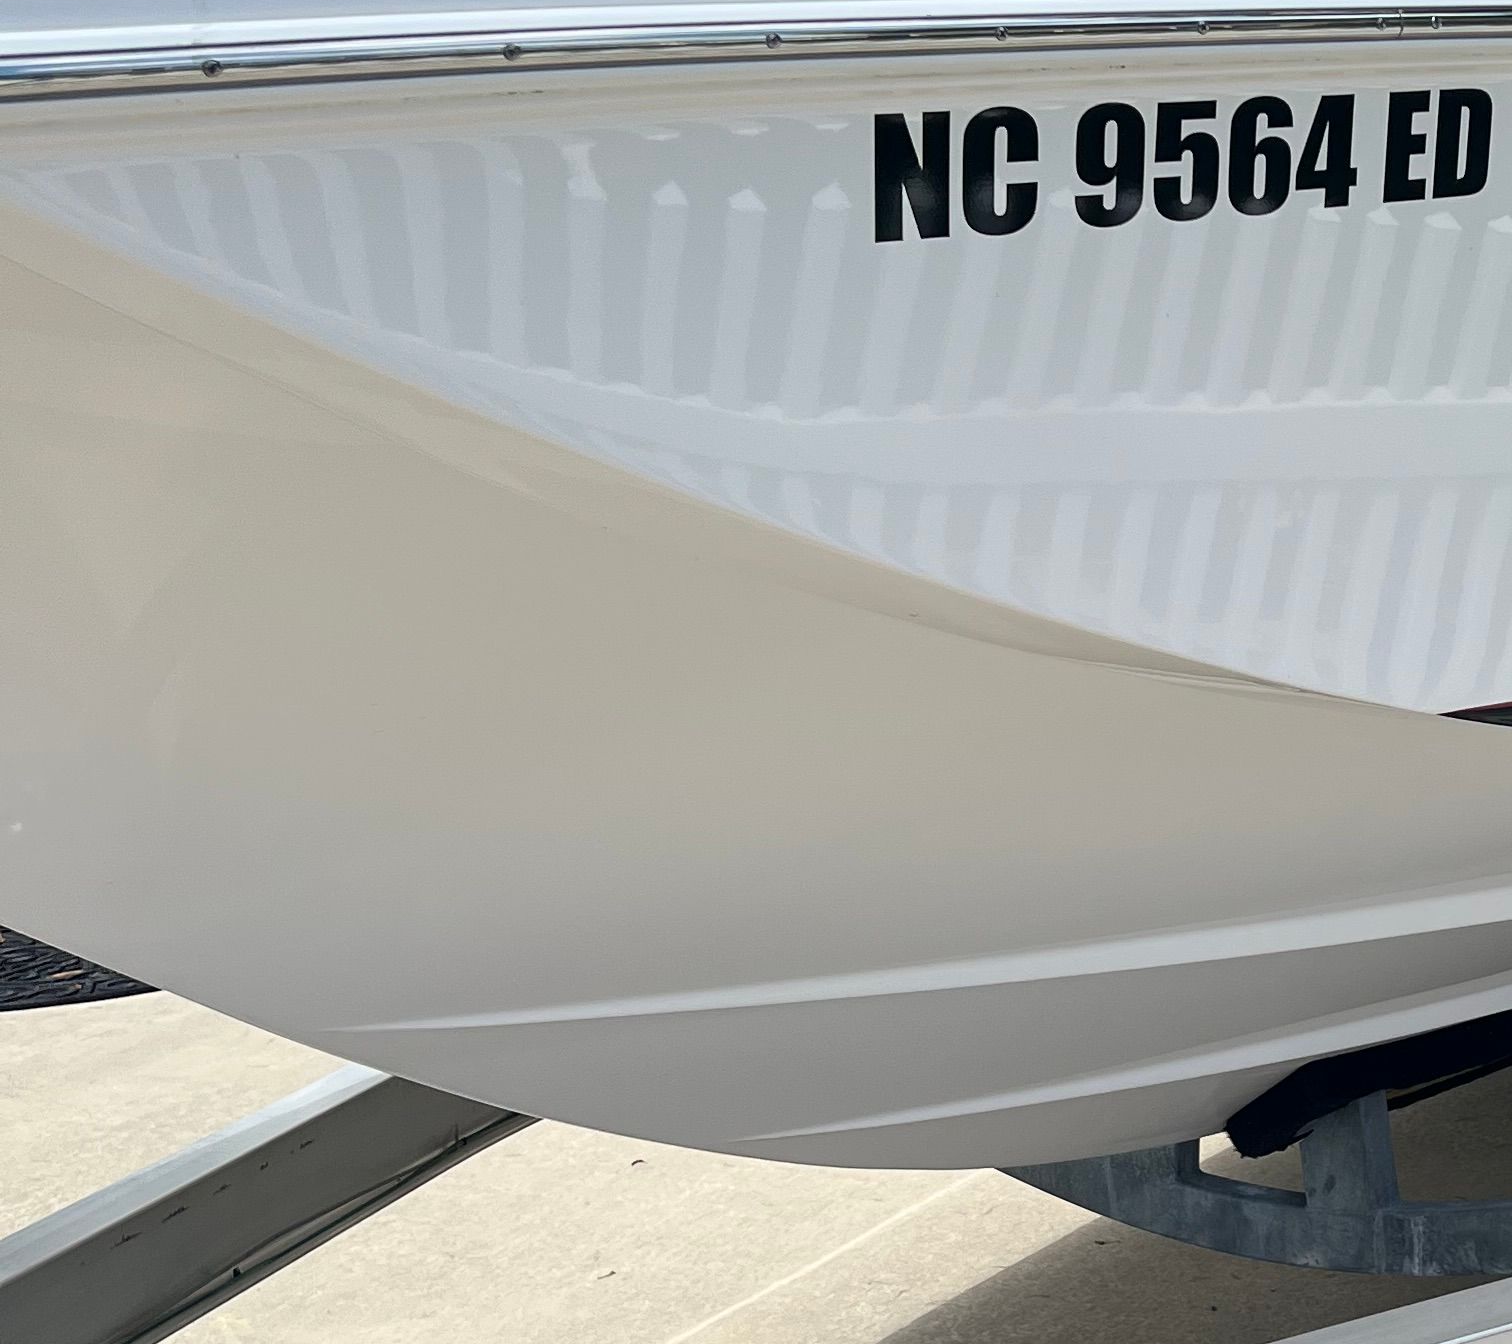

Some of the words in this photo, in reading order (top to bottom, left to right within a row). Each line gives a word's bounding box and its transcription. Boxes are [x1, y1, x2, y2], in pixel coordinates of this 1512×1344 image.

[874, 106, 1039, 242] NC
[1074, 93, 1358, 228] 9564
[1383, 87, 1494, 203] ED
